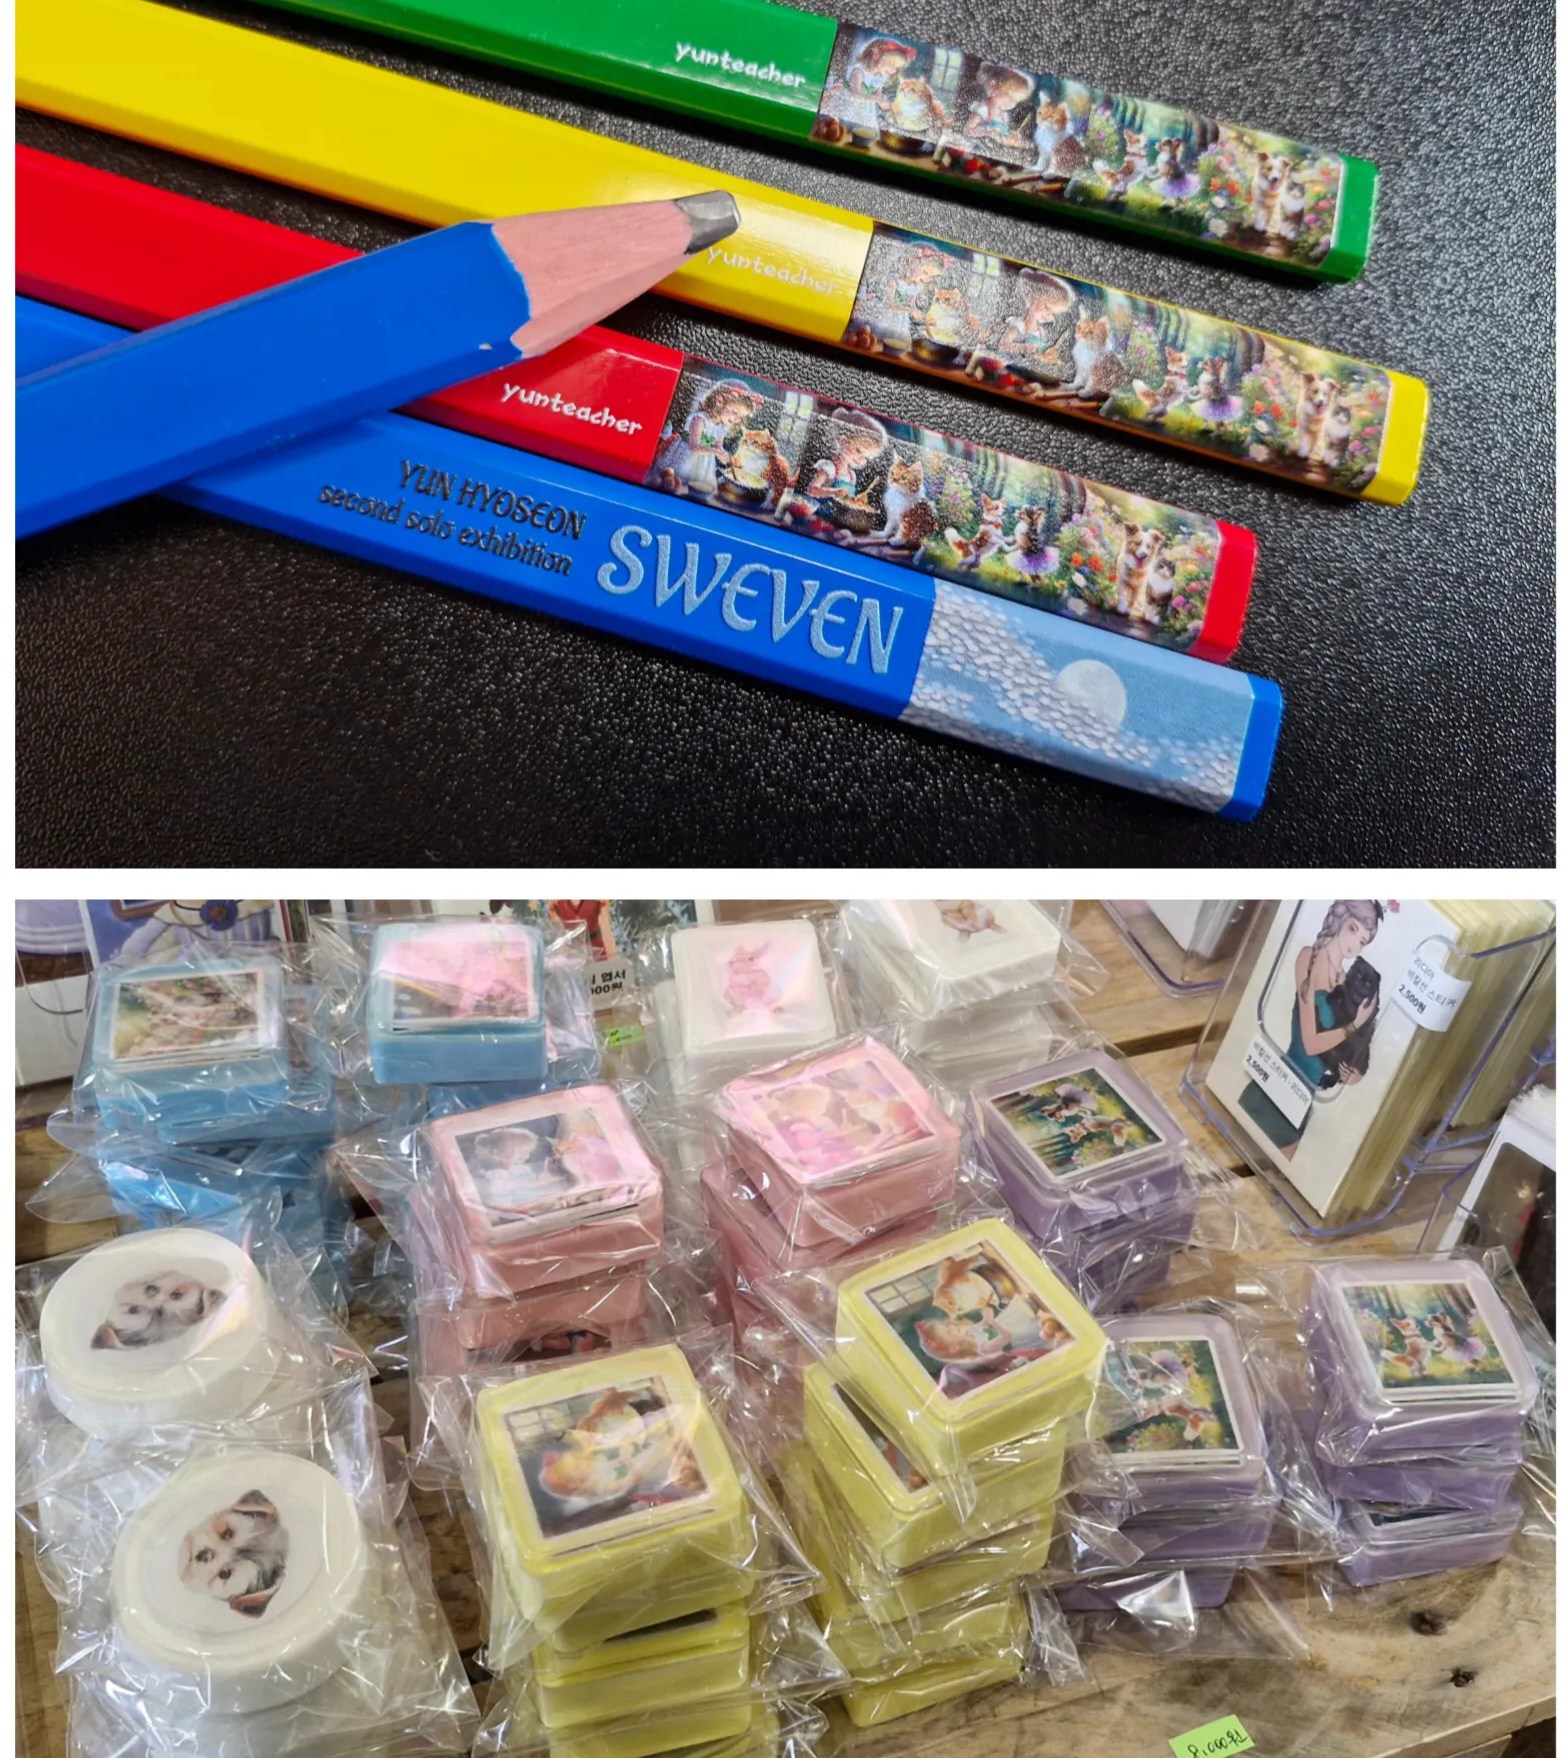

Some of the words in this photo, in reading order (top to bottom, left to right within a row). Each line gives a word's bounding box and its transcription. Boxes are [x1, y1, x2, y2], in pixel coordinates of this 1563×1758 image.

[675, 41, 806, 89] yunteacher
[705, 246, 840, 296] yunteacher
[501, 383, 643, 436] yunteacher
[399, 459, 459, 501] YUN
[457, 478, 588, 541] HYOSEON
[318, 485, 406, 524] second
[404, 509, 457, 540] solo
[458, 525, 574, 576] exhibition
[596, 525, 905, 675] SWEVEN
[601, 969, 626, 983] 엽서
[1414, 957, 1435, 980] 리디아
[1398, 984, 1427, 1015] 2,500원
[1426, 990, 1457, 1008] 스티커
